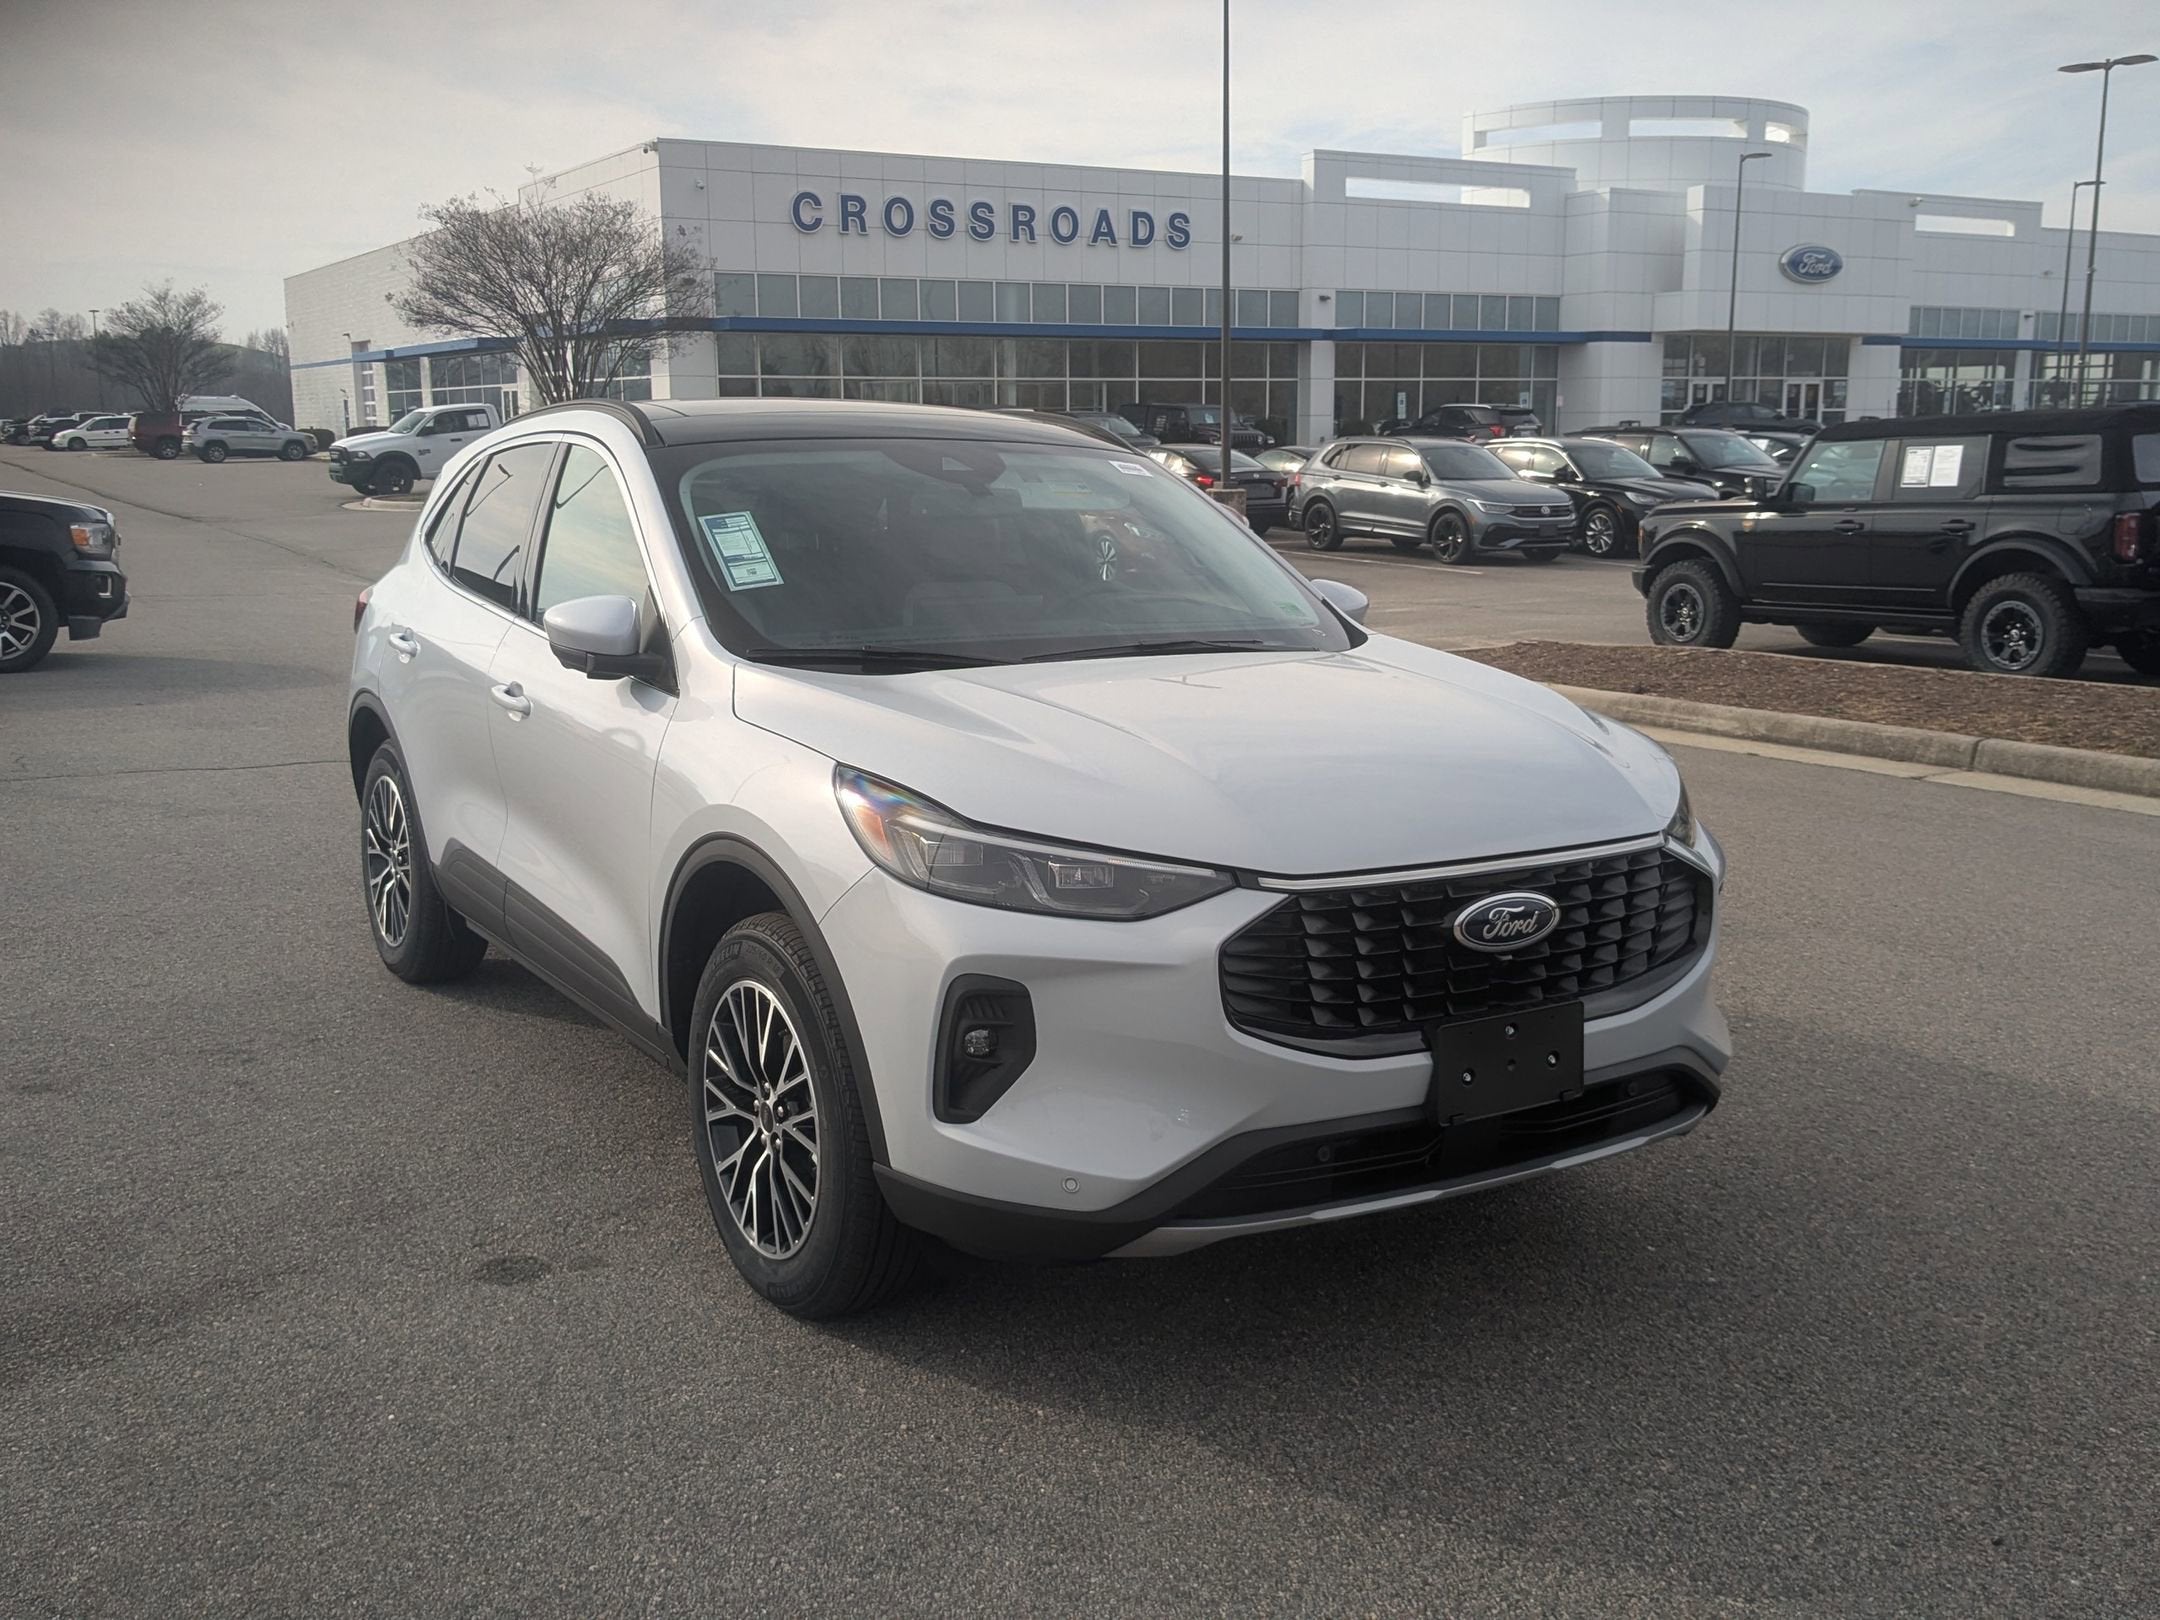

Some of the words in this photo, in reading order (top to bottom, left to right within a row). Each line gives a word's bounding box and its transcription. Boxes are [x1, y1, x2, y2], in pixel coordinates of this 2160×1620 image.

[791, 191, 1192, 250] CROSSROADS
[1798, 252, 1834, 274] Ford
[1482, 905, 1539, 939] Ford
